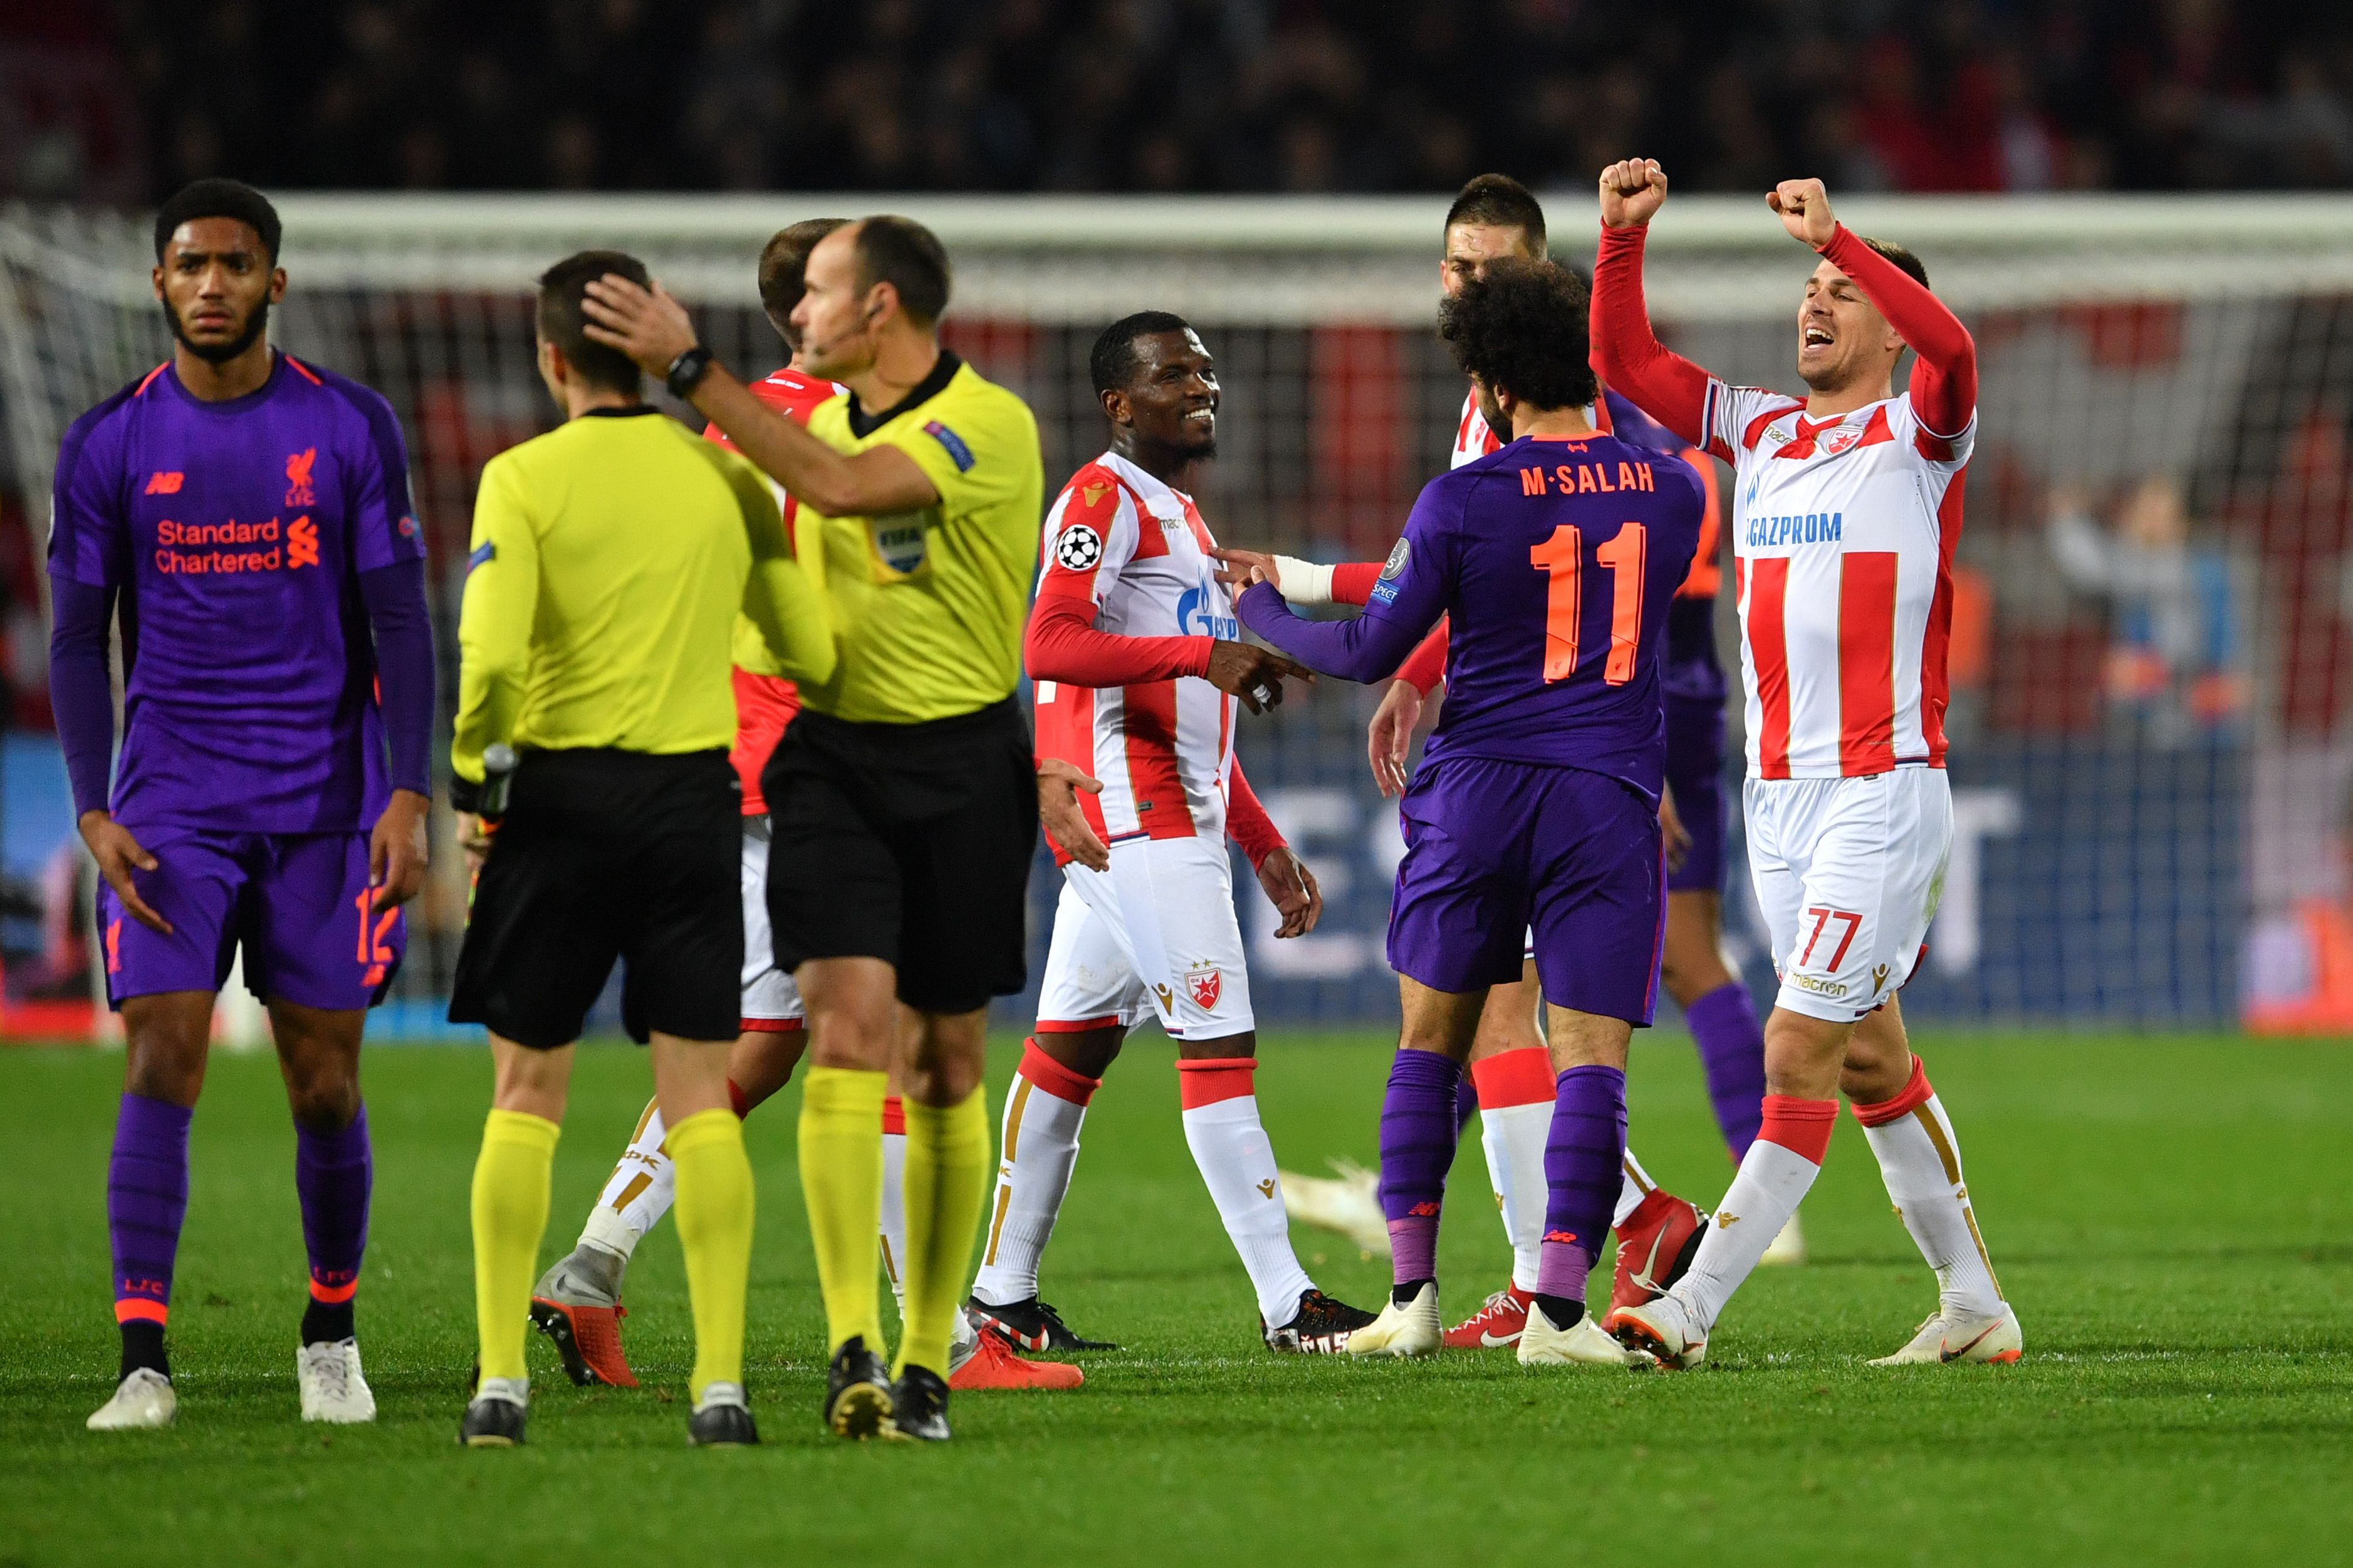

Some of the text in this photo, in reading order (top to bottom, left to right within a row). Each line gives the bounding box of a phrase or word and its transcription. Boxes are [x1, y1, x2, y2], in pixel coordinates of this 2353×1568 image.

[158, 517, 279, 546] Standard
[1750, 512, 1842, 547] GAZPROM
[155, 546, 281, 573] Chartered
[1372, 584, 1397, 600] SPECT
[1530, 522, 1646, 685] 11
[353, 887, 399, 964] 12
[1799, 908, 1863, 973] 77
[1790, 972, 1847, 997] macron
